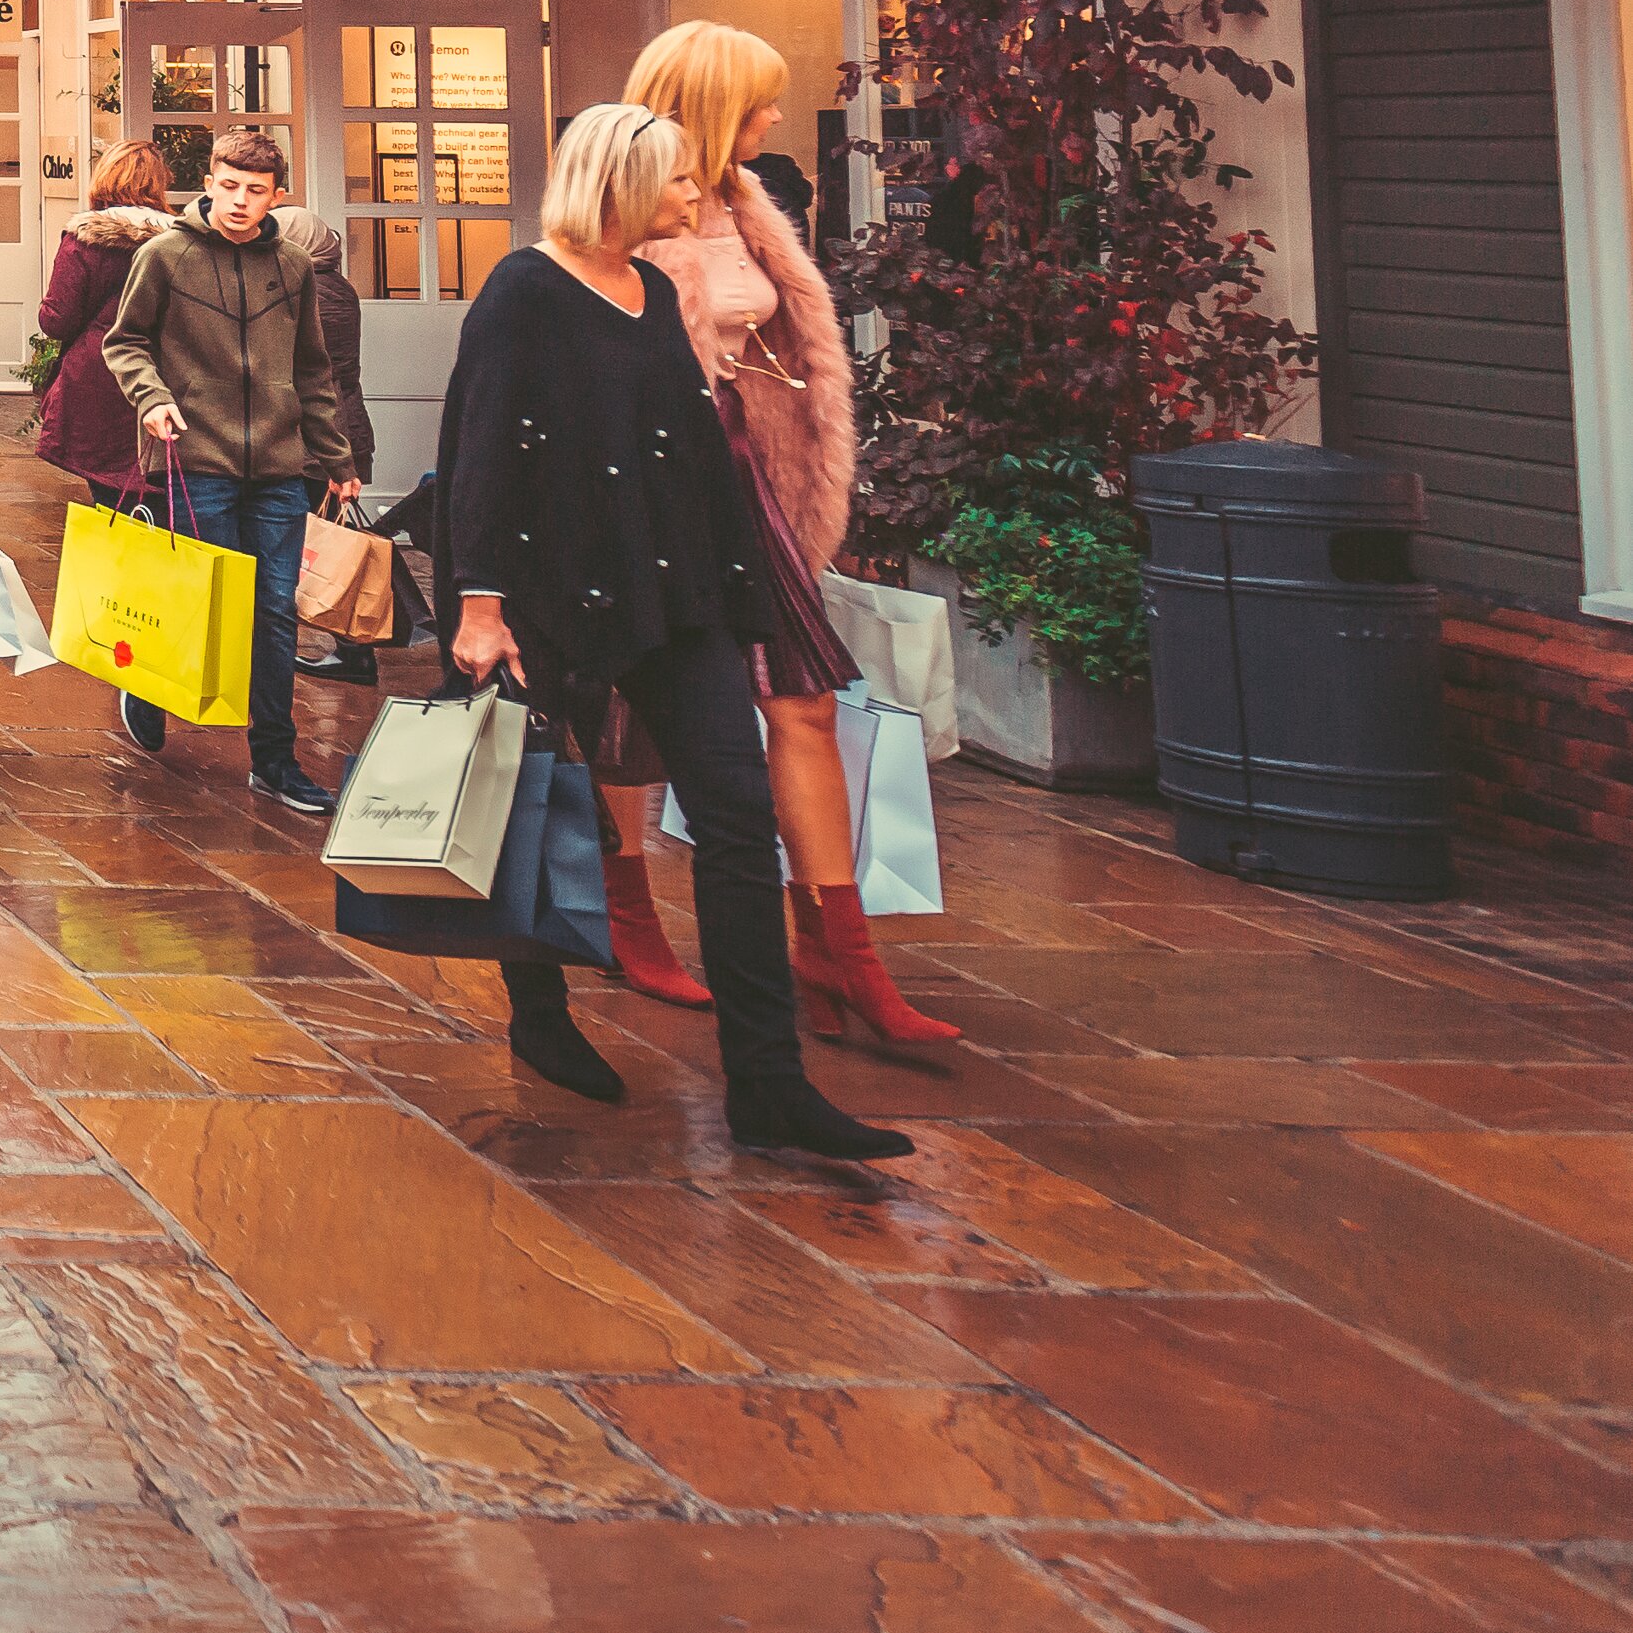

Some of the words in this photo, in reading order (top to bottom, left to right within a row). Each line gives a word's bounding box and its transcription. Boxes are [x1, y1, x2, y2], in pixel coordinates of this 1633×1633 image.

[391, 72, 411, 80] Who
[452, 73, 476, 82] We're
[473, 88, 494, 96] from
[391, 100, 415, 108] Cana
[392, 128, 417, 136] innov
[479, 130, 499, 139] gear
[487, 157, 503, 166] live
[43, 154, 73, 180] Chloé
[394, 170, 413, 178] best
[477, 172, 505, 181] you're
[470, 186, 504, 194] outside
[889, 202, 932, 218] PANTS
[395, 225, 412, 234] Est.
[101, 596, 118, 611] TED
[126, 607, 160, 628] BAKER
[349, 795, 440, 833] Temperley
